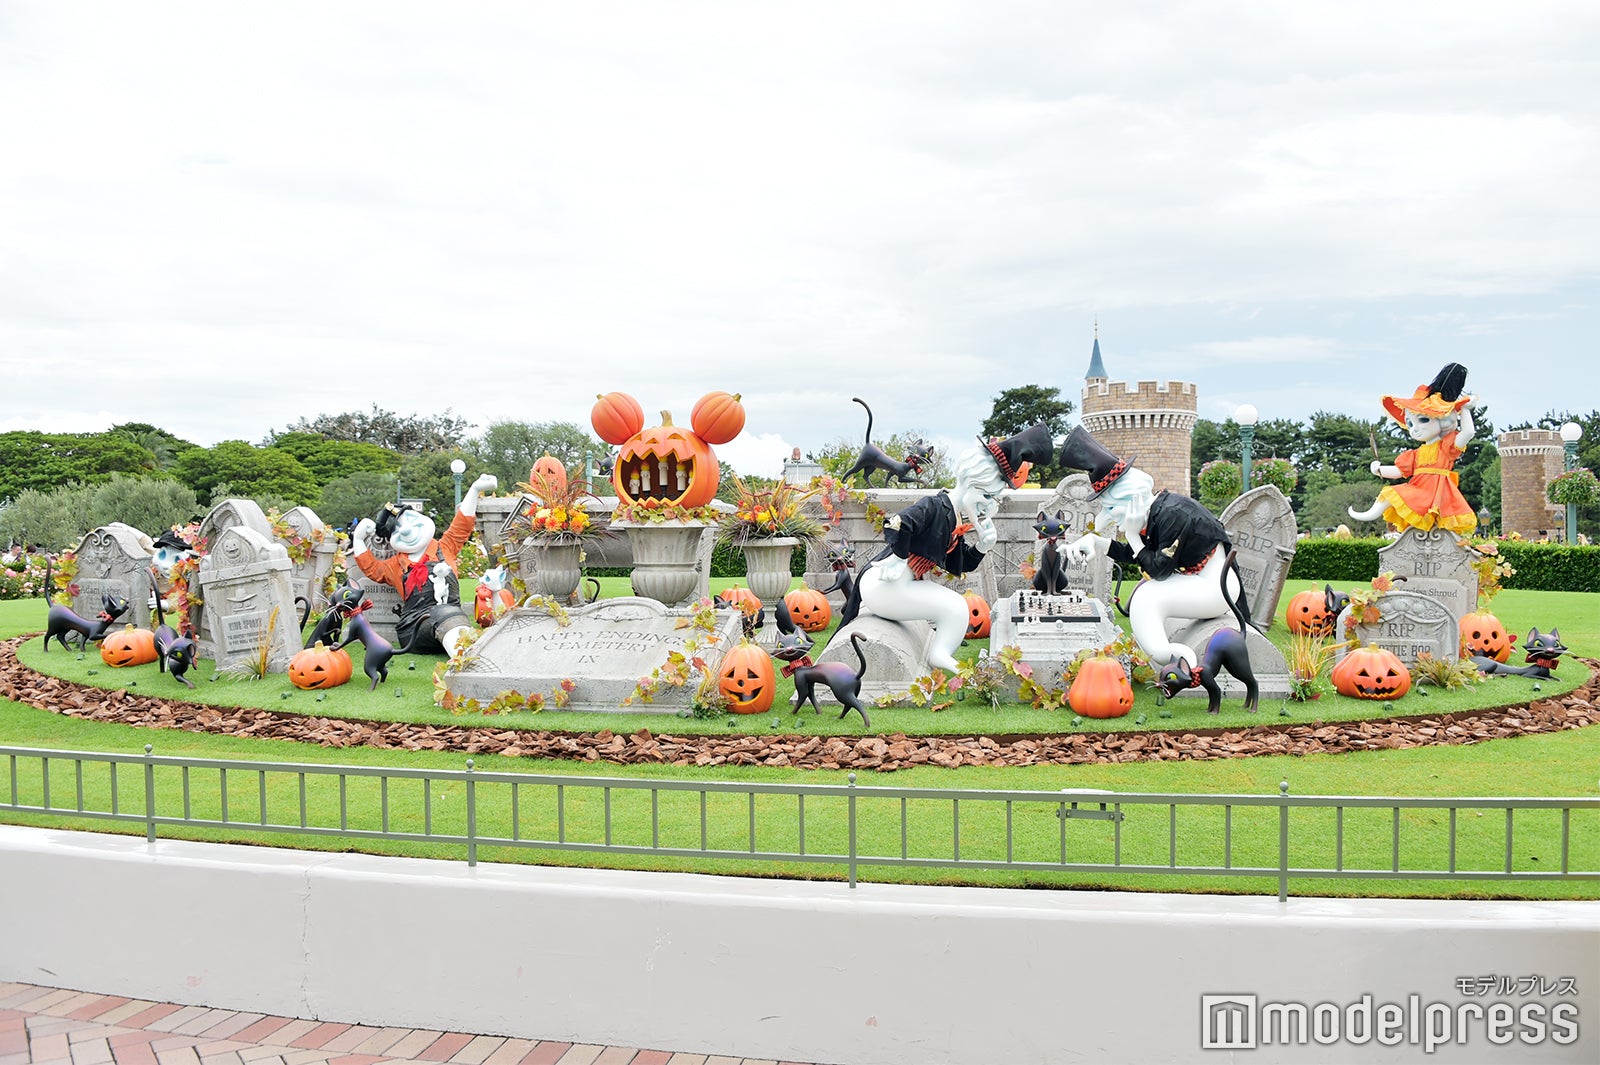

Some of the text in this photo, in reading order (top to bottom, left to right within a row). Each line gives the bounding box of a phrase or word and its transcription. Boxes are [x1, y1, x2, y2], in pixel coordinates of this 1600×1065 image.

[1233, 530, 1274, 553] RIP
[1413, 561, 1442, 577] RIP
[364, 585, 379, 594] Bill
[1429, 588, 1458, 598] Shroud
[1387, 622, 1416, 638] RIP
[517, 631, 591, 644] HAPPY
[543, 641, 655, 652] CEMETERY
